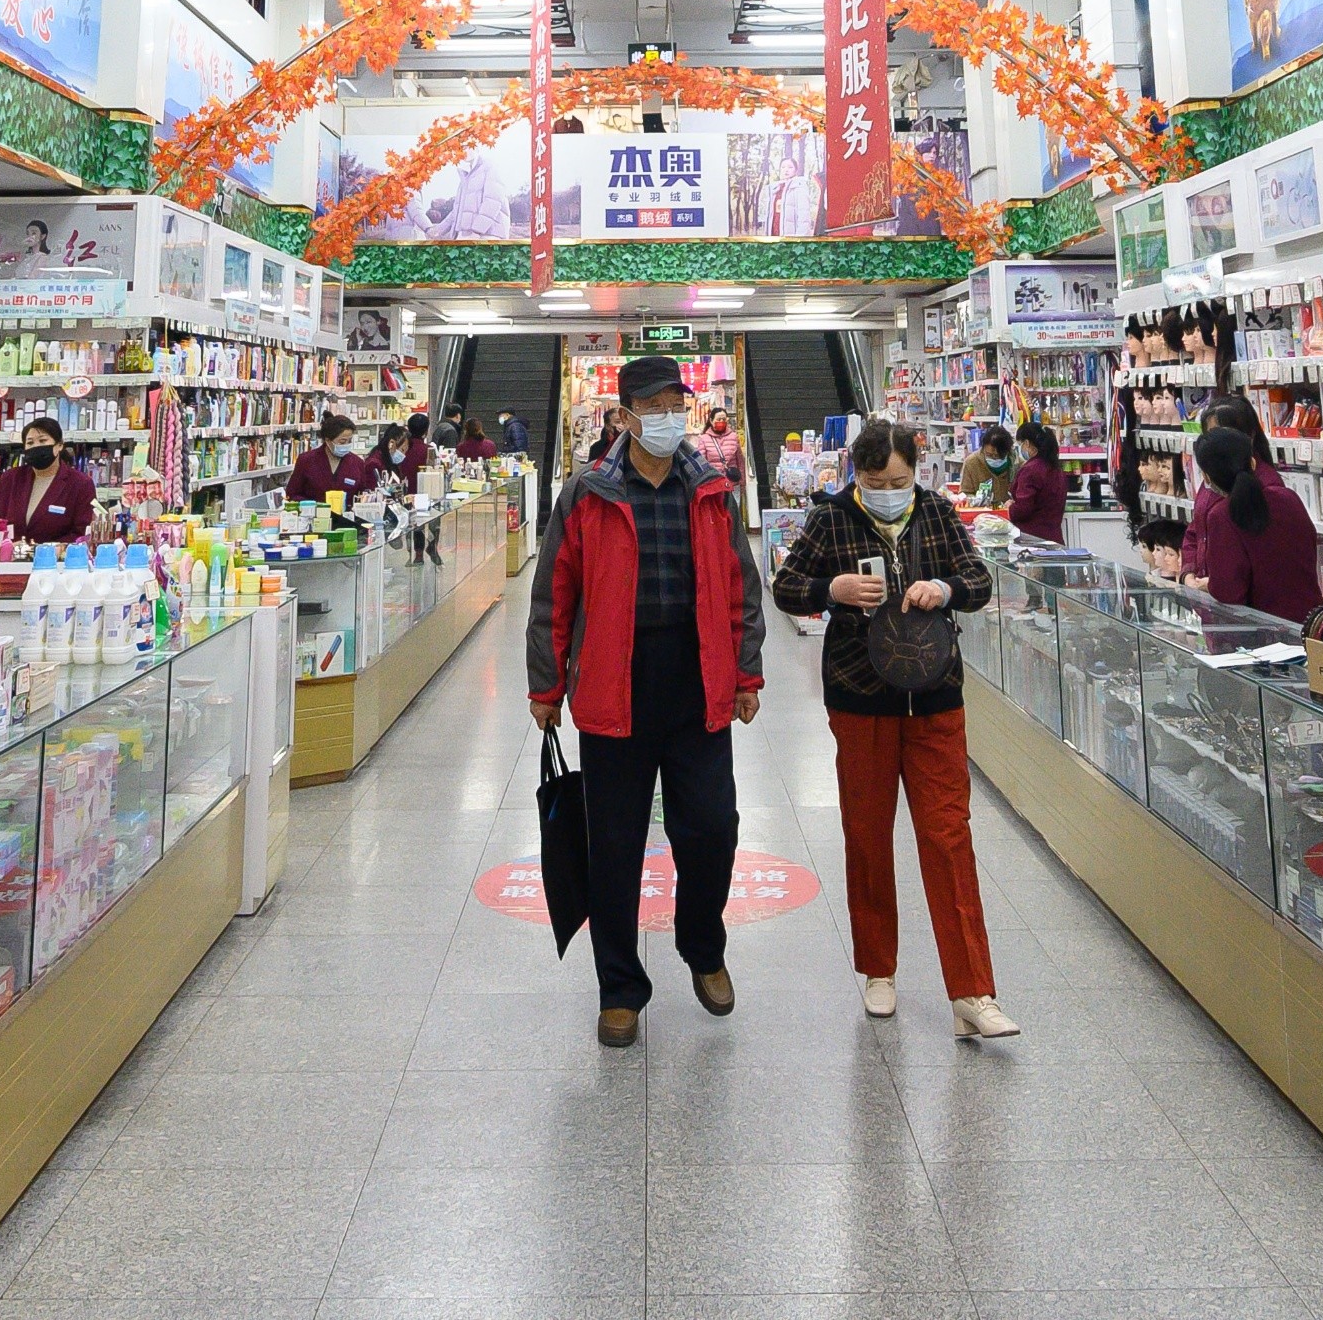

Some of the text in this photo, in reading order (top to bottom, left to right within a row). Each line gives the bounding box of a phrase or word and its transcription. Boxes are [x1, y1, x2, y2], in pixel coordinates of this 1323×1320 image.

[607, 145, 702, 188] 杰奥
[607, 191, 702, 203] 专业羽绒服
